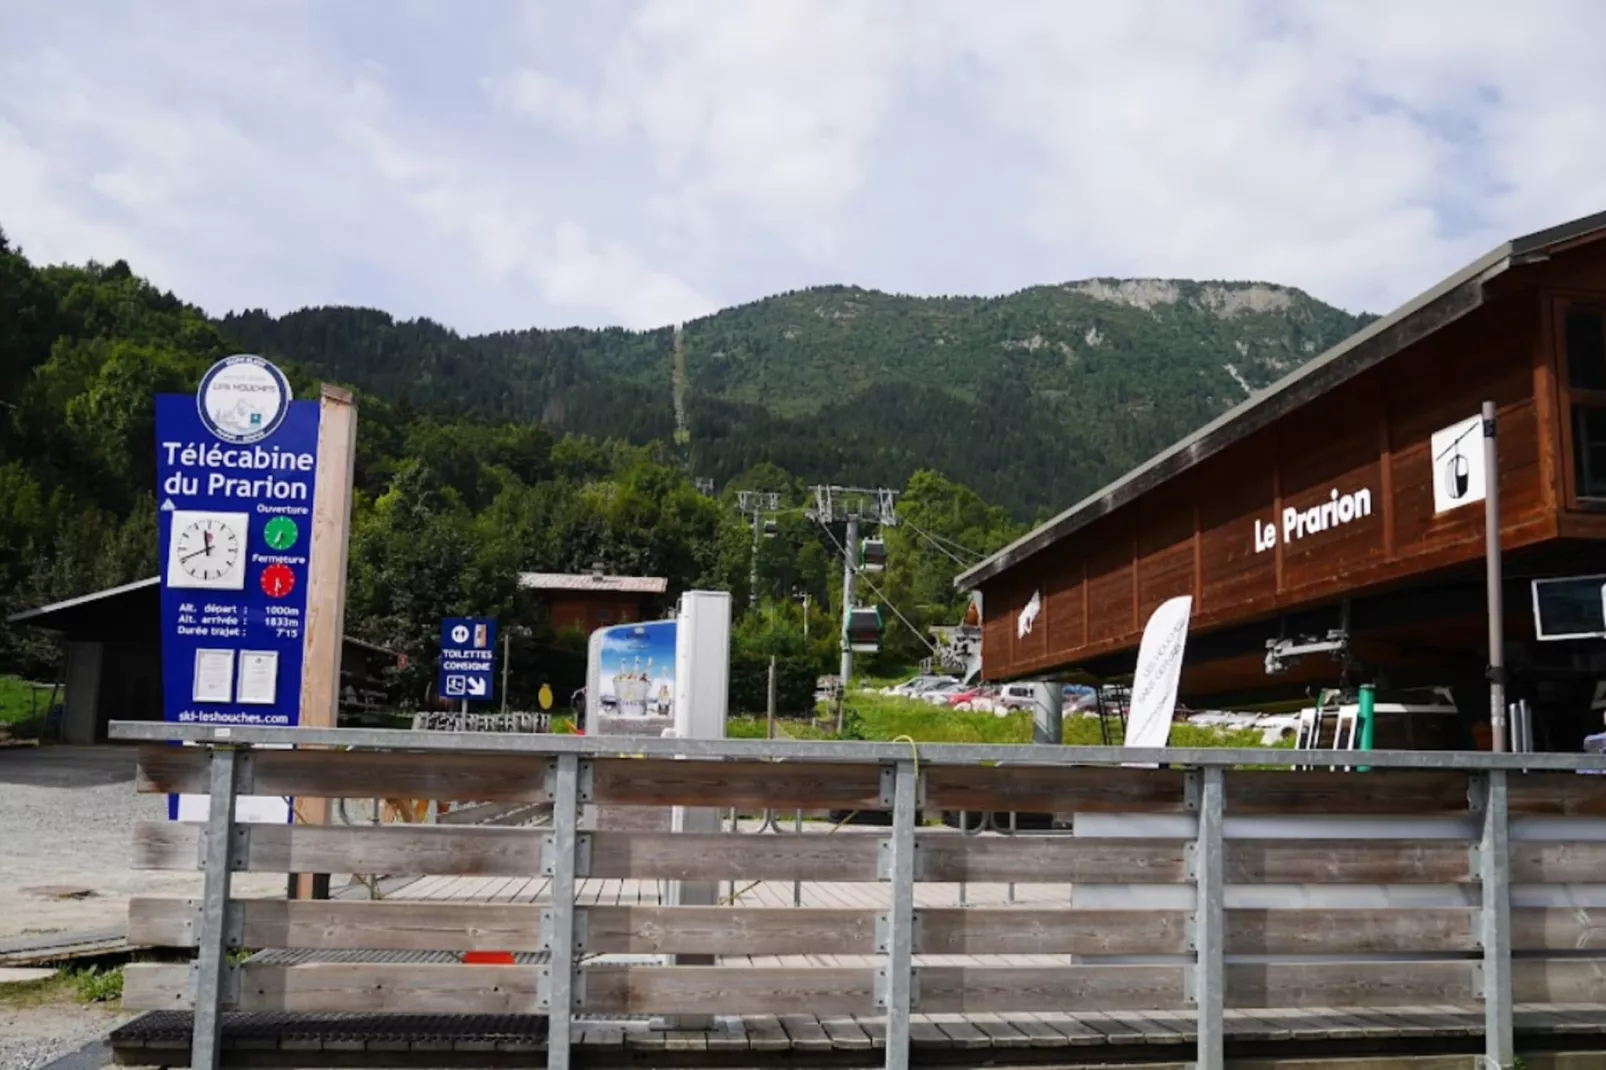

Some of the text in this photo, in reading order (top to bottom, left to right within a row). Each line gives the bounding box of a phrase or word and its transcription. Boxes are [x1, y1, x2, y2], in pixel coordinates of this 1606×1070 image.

[162, 441, 313, 471] Télécabine
[164, 471, 307, 500] du Prarion
[257, 503, 308, 515] Ouverture
[1255, 488, 1371, 553] Le Prarion
[252, 553, 306, 564] Fermeture
[178, 603, 197, 613] Alt.
[204, 603, 237, 615] départ
[265, 606, 299, 616] 1000m
[178, 615, 197, 624] Alt.
[201, 615, 238, 625] arrivée
[265, 617, 299, 627] 1833m
[177, 625, 208, 636] Durée
[211, 626, 240, 638] trajet
[442, 648, 493, 660] TOILETTES
[443, 660, 491, 671] CONSIGNE
[178, 711, 289, 725] ski-leshouches.com
